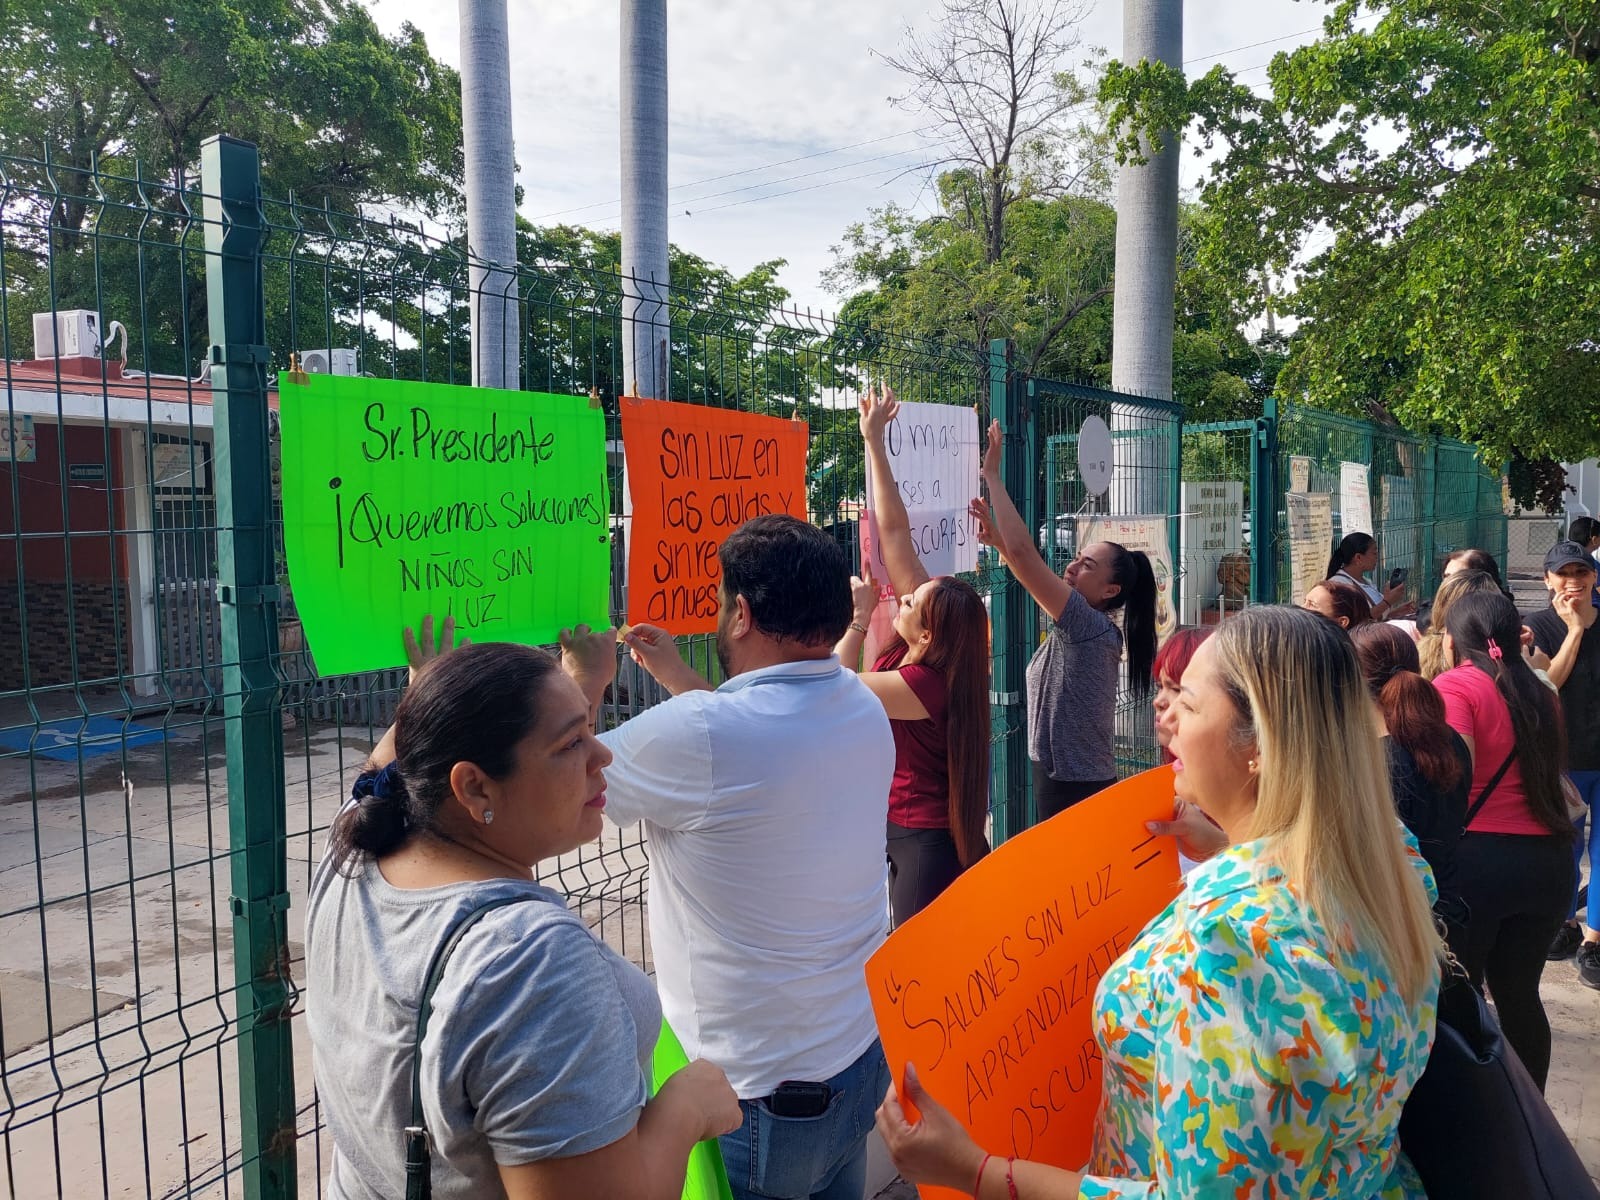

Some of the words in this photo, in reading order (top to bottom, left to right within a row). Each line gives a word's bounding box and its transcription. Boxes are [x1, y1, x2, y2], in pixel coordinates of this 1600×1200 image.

[362, 402, 405, 463] Sr.
[410, 406, 555, 468] Presidente
[706, 431, 752, 481] LUZ
[753, 438, 779, 478] en
[887, 416, 903, 457] O
[908, 423, 960, 457] mas
[661, 481, 702, 534] las
[710, 485, 770, 527] aulas
[895, 480, 925, 508] ses
[328, 476, 498, 569] ¡Queremos
[398, 552, 484, 592] NIÑOS
[492, 546, 534, 582] SIN
[695, 540, 720, 579] re
[448, 594, 504, 630] LUZ
[671, 580, 721, 621] nues
[1025, 899, 1064, 958] SIN
[1072, 863, 1123, 920] LUZ
[1011, 1038, 1103, 1161] OSCUR
